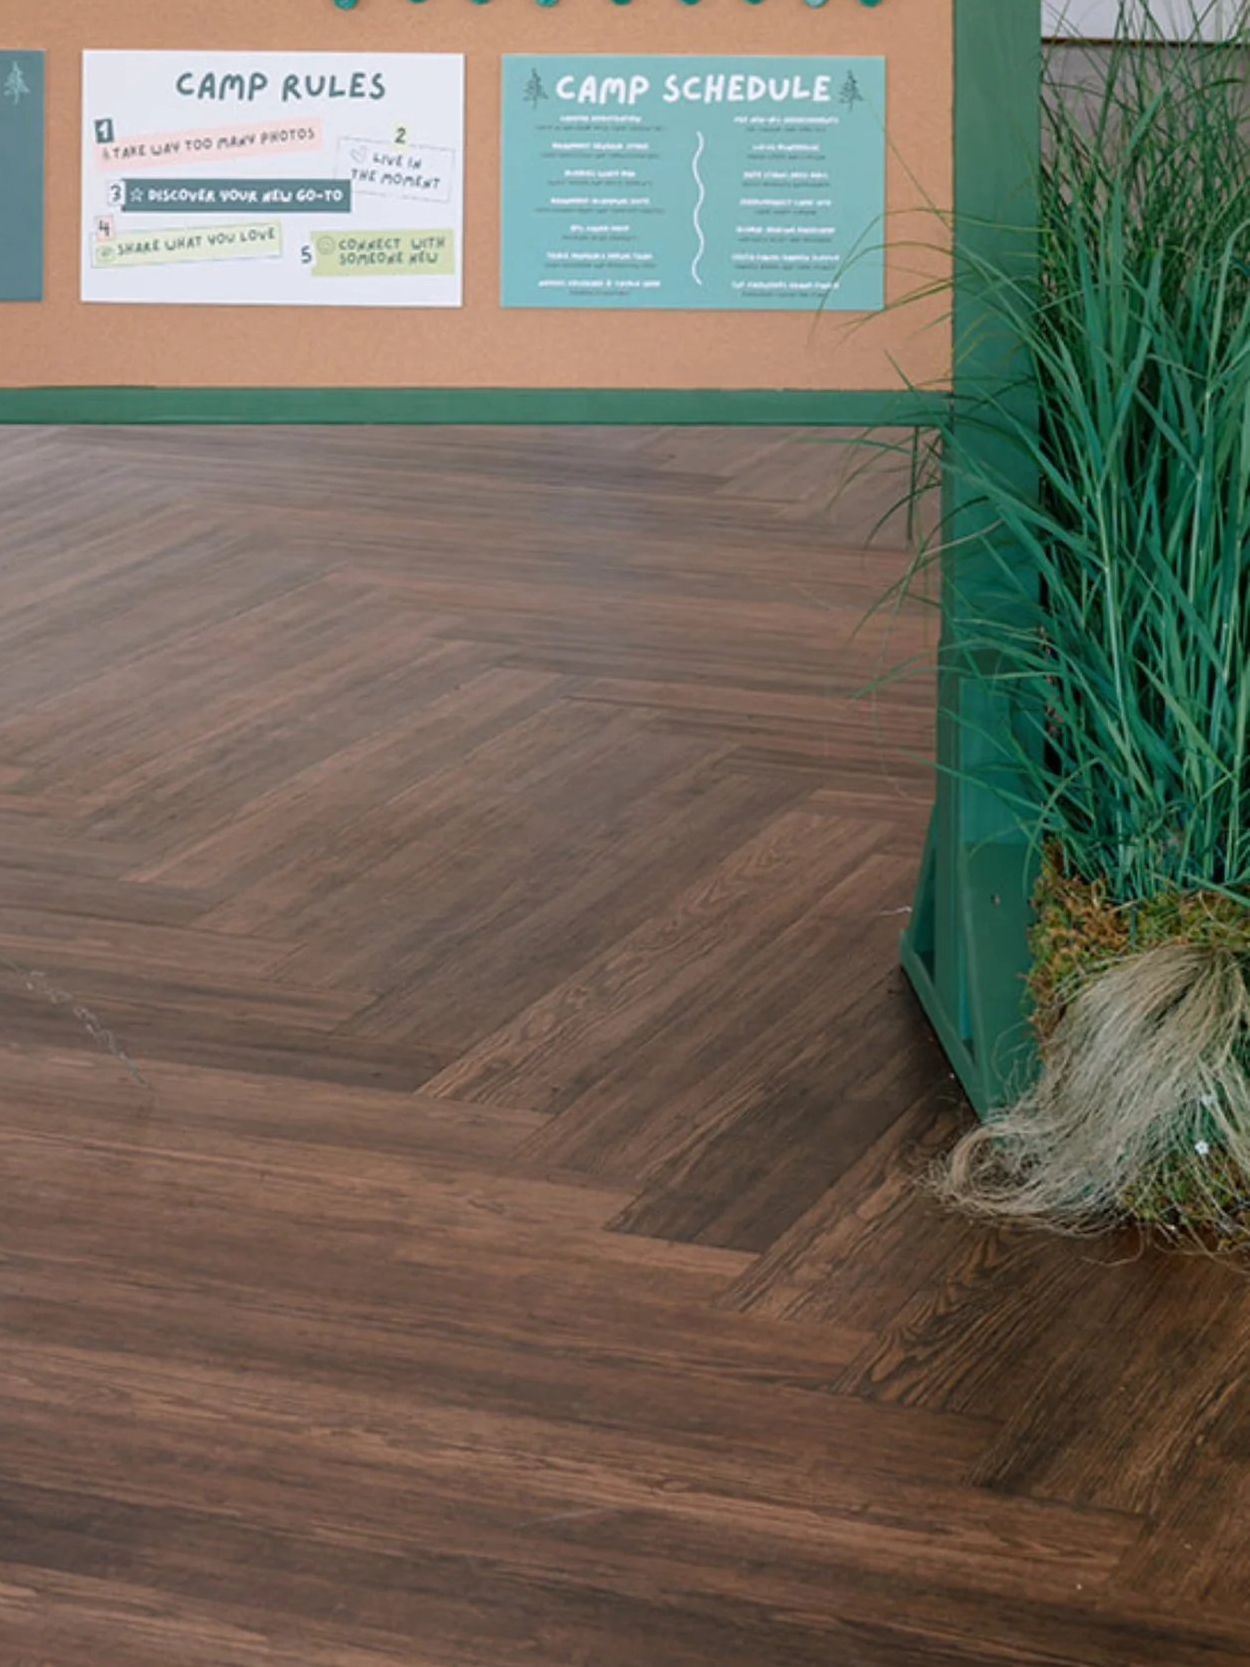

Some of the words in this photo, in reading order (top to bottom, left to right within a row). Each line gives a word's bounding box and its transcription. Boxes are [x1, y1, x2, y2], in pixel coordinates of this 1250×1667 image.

[176, 72, 268, 102] CAMP
[281, 72, 387, 102] RULES
[556, 74, 649, 105] CAMP
[662, 74, 832, 104] SCHEDULE
[113, 143, 147, 159] TAKE
[150, 142, 181, 157] WAY
[185, 138, 213, 152] TOO
[217, 134, 256, 150] MANY
[260, 127, 316, 145] PHOTOS
[394, 126, 406, 144] 2
[372, 152, 403, 168] LIVE
[350, 168, 377, 182] THE
[380, 172, 441, 190] MOMENT
[110, 185, 122, 201] 3
[147, 189, 216, 203] DISCOVER
[219, 189, 259, 203] YOUR
[261, 190, 292, 203] NEW
[295, 189, 344, 202] GO-TO
[98, 220, 111, 236] 4
[117, 238, 159, 255] SHARE
[163, 236, 202, 251] WHAT
[206, 231, 237, 246] YOU
[240, 227, 276, 242] LOVE
[338, 238, 402, 251] CONNECT
[410, 236, 446, 250] WITH
[301, 245, 313, 264] 5
[339, 252, 403, 266] SOMEONE
[409, 252, 439, 265] NEW
